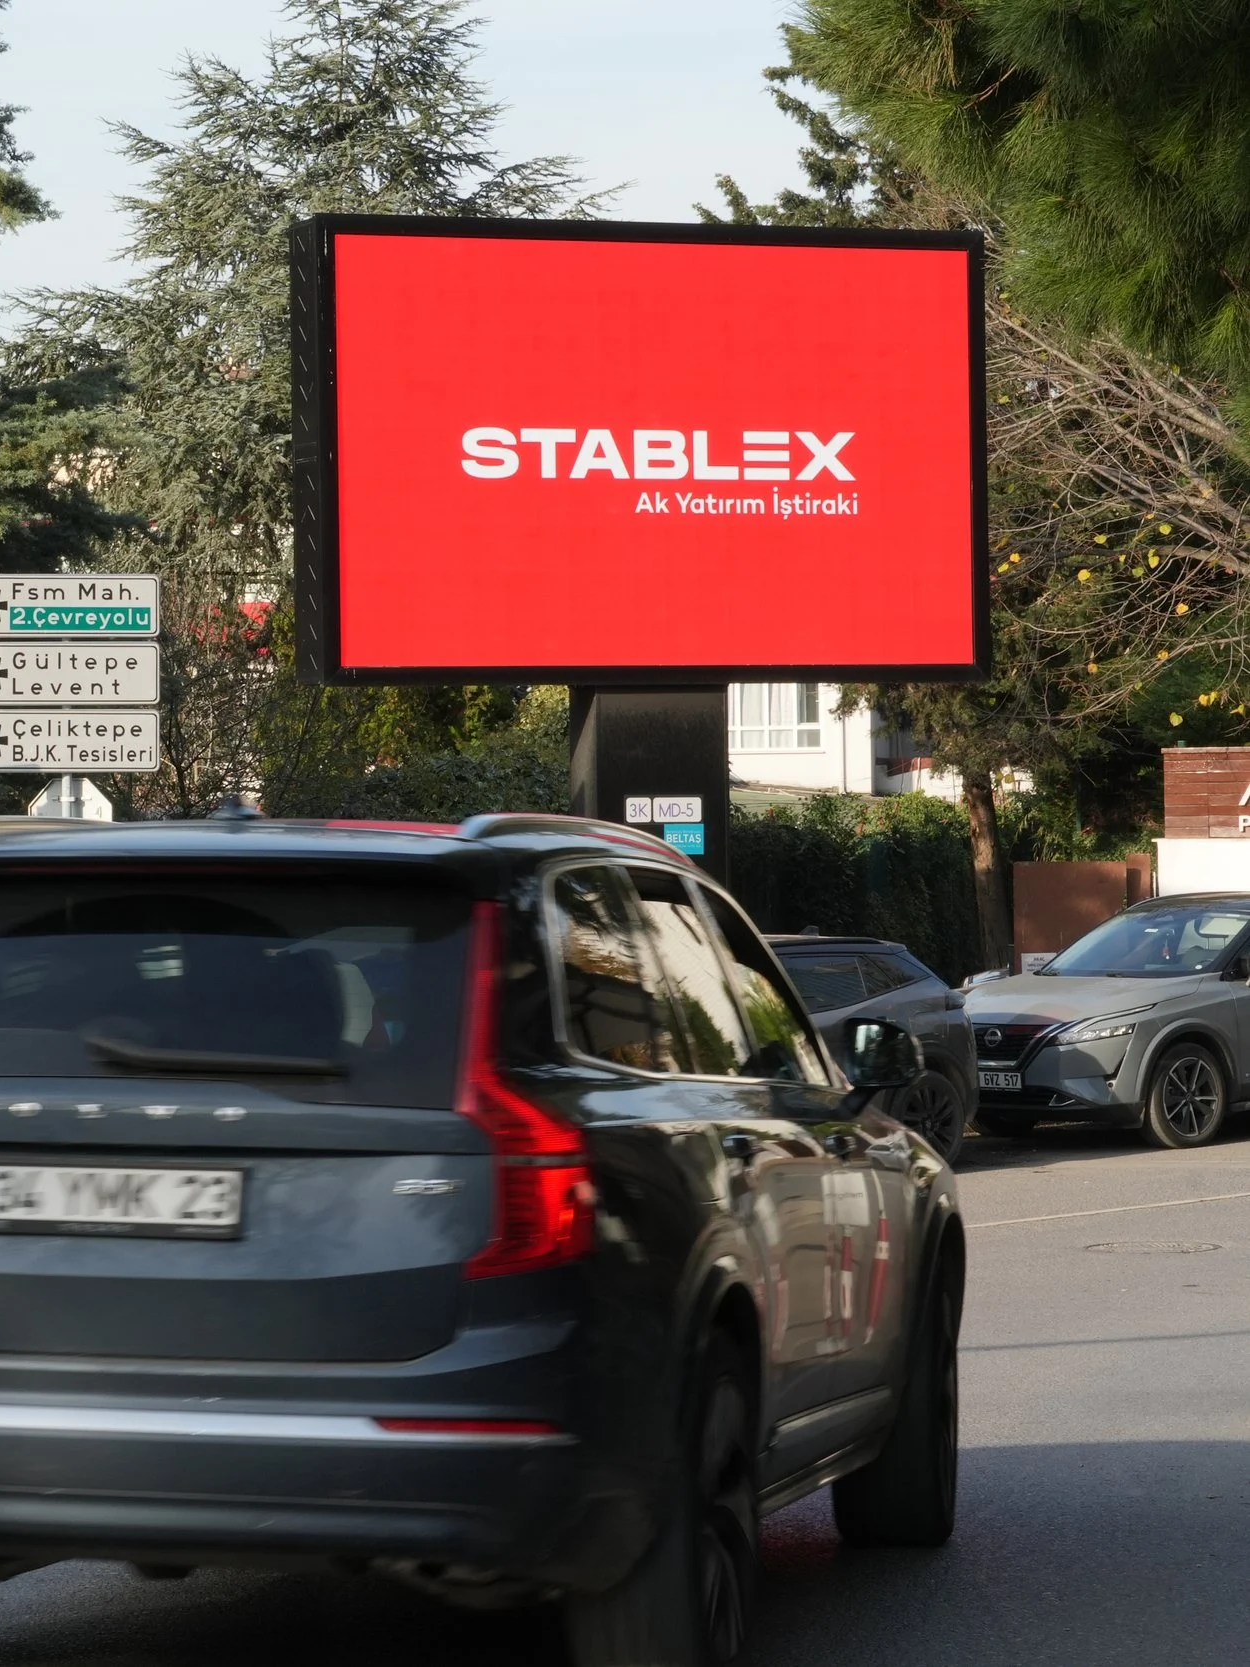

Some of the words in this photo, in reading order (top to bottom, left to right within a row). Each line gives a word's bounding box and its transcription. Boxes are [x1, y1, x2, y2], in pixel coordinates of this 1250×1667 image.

[461, 426, 856, 481] STABLEX
[635, 492, 669, 514] Ak
[675, 492, 765, 515] Yatırım
[773, 486, 859, 520] İştiraki
[12, 583, 65, 600] Fsm
[78, 583, 139, 600] Mah.
[12, 607, 149, 630] 2.Çevreyolu
[12, 652, 138, 674] Gültepe
[12, 678, 121, 695] Levent
[12, 719, 143, 742] Çeliktepe
[12, 745, 61, 762] B.J.K.
[66, 745, 153, 762] Tesisleri
[629, 803, 648, 818] 3K
[658, 803, 694, 818] MD-5
[666, 833, 702, 844] BELTAŞ
[1003, 1074, 1019, 1087] 517
